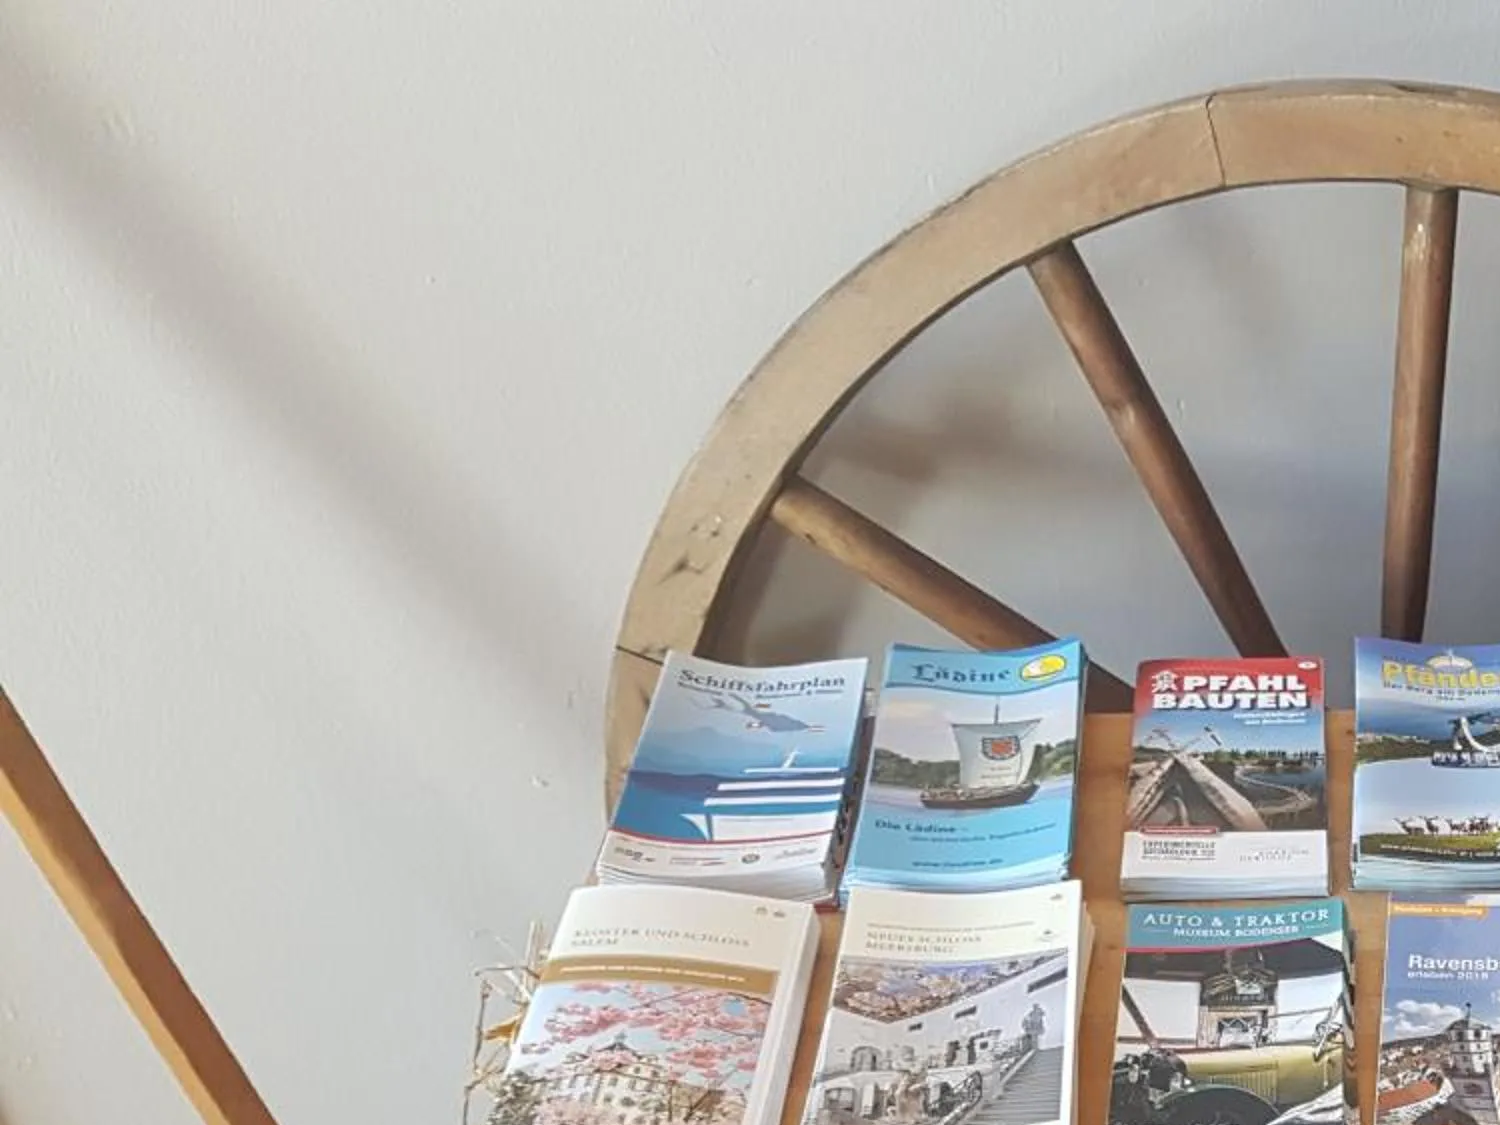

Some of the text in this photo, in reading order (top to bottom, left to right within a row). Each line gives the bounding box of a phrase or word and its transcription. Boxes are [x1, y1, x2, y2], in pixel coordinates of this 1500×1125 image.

[1183, 674, 1308, 692] PFAHL
[1152, 692, 1309, 710] BAUTEN
[1143, 907, 1330, 928] AUTO & TRAKTOR
[1173, 925, 1300, 938] MUSEUM BODENSEE
